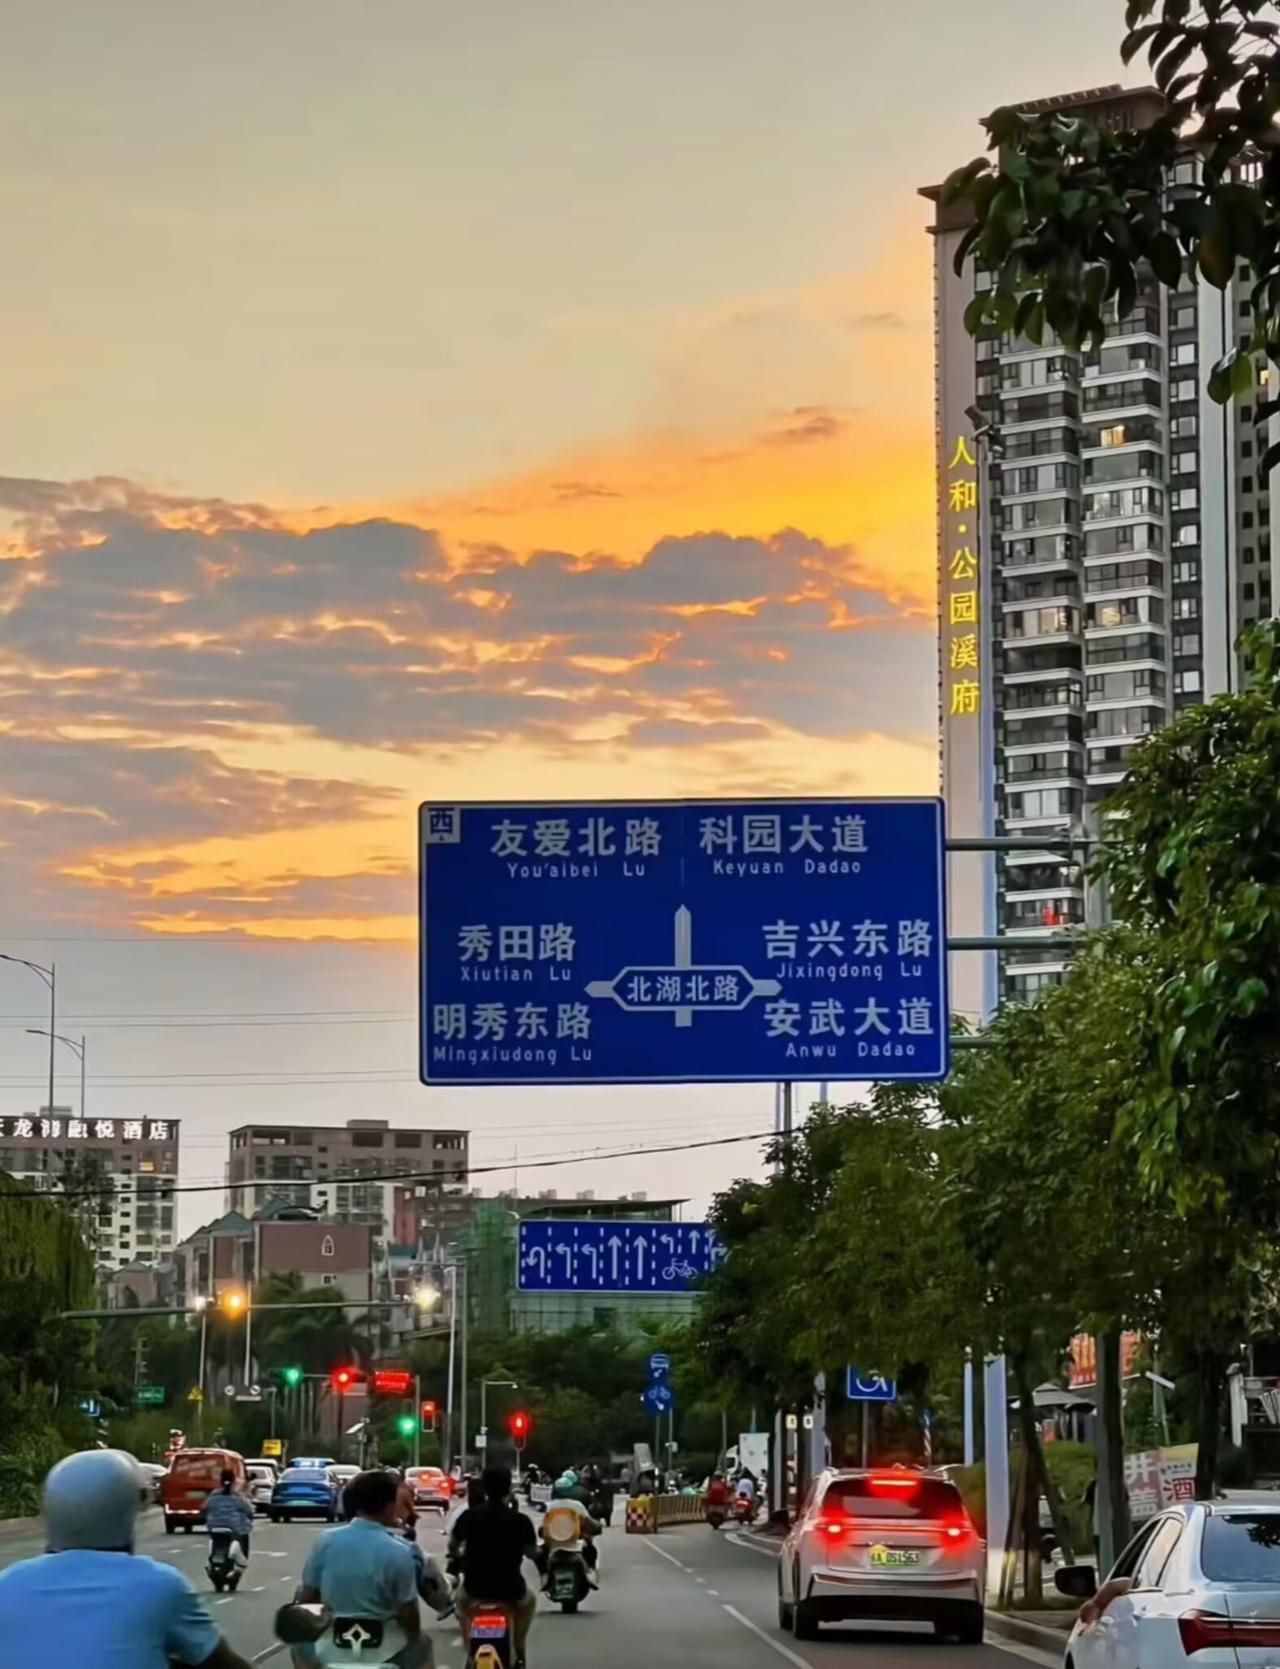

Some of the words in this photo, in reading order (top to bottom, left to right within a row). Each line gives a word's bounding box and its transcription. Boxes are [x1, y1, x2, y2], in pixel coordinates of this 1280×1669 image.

[949, 435, 980, 716] 人和·公园溪府
[429, 807, 454, 835] 西
[700, 815, 868, 854] 科园大道
[491, 817, 661, 857] 友爱北路
[508, 862, 597, 878] You'aibei
[624, 862, 644, 876] Lu
[714, 860, 783, 877] Keyuan
[805, 859, 860, 874] Dadao
[458, 923, 576, 961] 秀田路
[762, 919, 932, 958] 吉兴东路
[461, 966, 532, 981] Xiutian
[550, 966, 570, 980] Lu
[776, 962, 883, 982] Jixingdong
[901, 962, 921, 976] Lu
[627, 975, 739, 1002] 北湖北路
[434, 1002, 591, 1041] 明秀东路
[763, 997, 934, 1037] 安武大道
[434, 1046, 556, 1065] Mingxiudong
[571, 1046, 591, 1061] Lu
[786, 1043, 836, 1057] Anwu
[858, 1042, 915, 1056] Dadao
